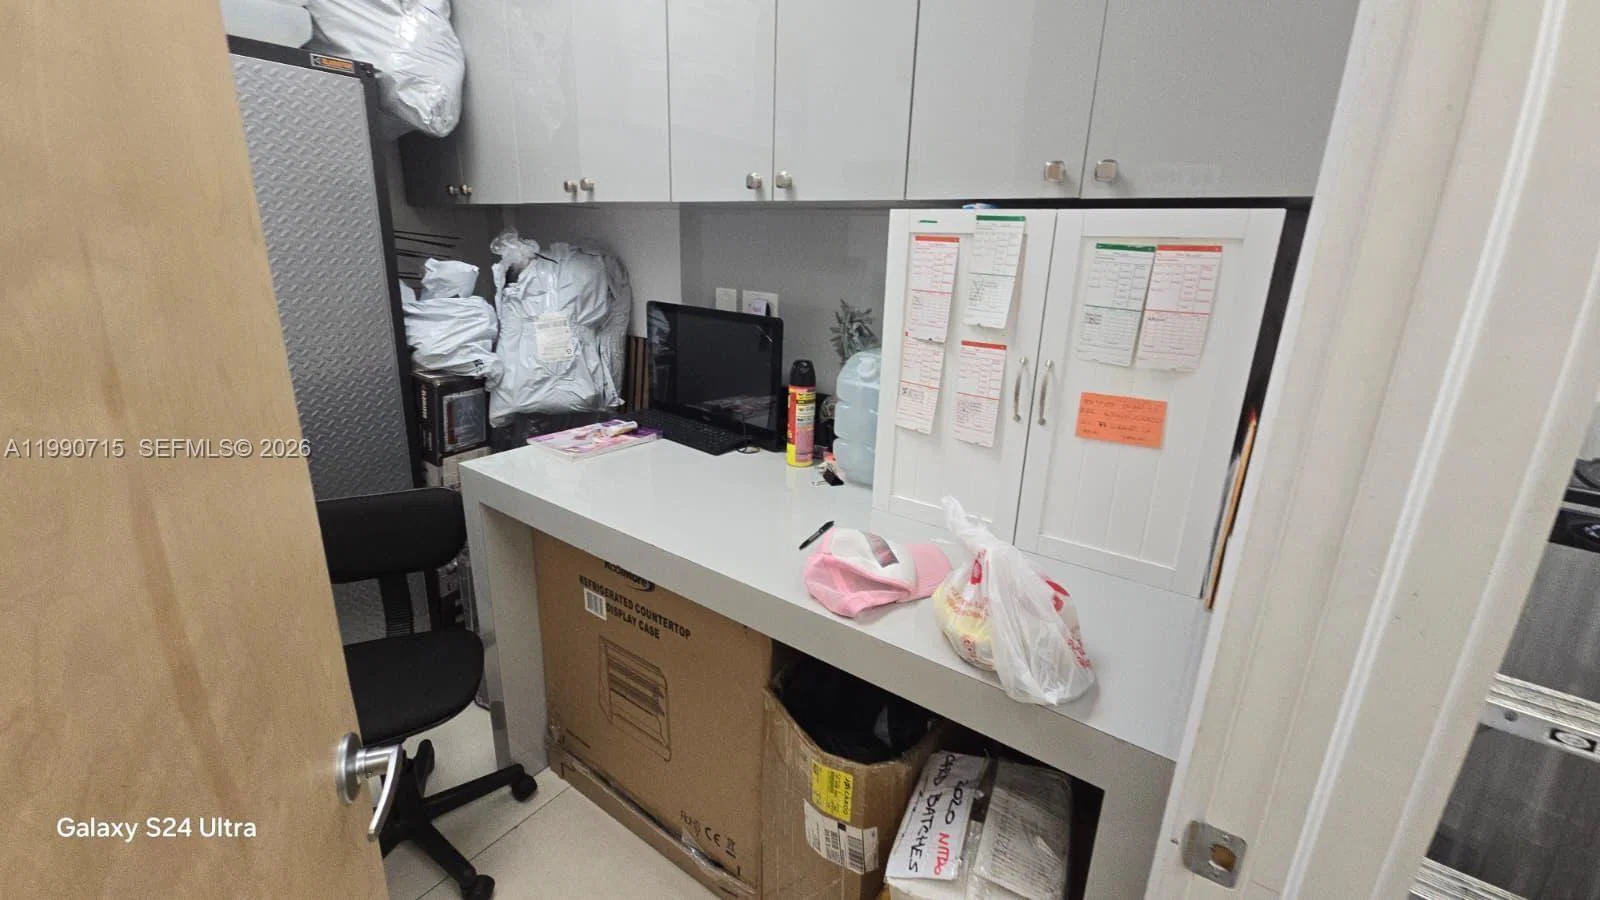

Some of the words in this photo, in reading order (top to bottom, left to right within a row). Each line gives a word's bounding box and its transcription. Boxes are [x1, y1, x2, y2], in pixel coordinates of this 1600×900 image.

[579, 574, 634, 610] REFRIGERATED
[635, 603, 691, 640] COUNTERTOP
[606, 603, 637, 627] DISPLAY
[639, 620, 660, 640] CASE
